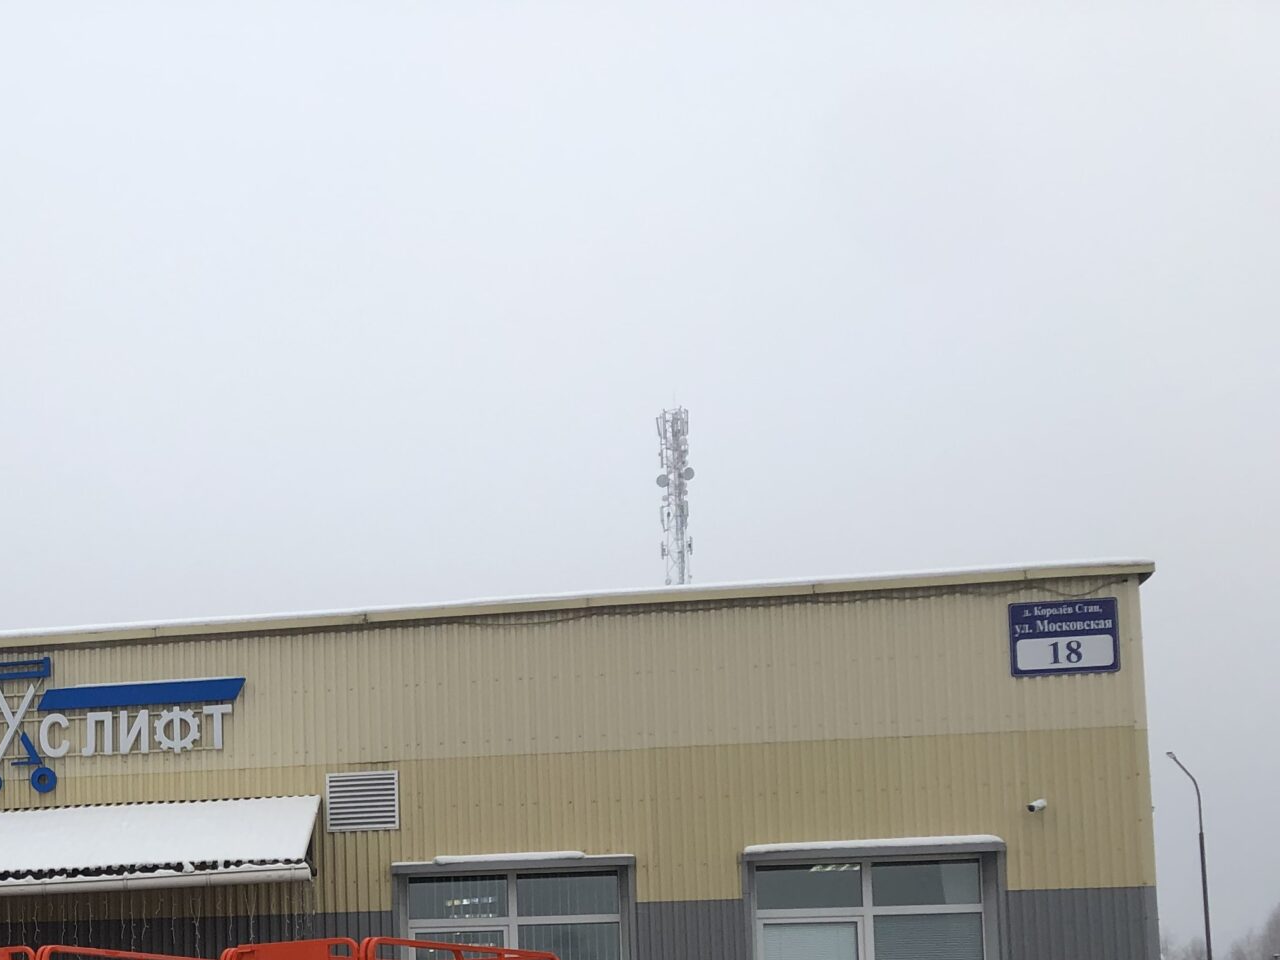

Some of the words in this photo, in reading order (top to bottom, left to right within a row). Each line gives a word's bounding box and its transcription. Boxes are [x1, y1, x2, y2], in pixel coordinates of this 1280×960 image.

[1014, 624, 1032, 637] ул.
[1036, 619, 1112, 633] Московская
[1048, 640, 1083, 665] 18
[81, 704, 233, 755] ЛИФТ
